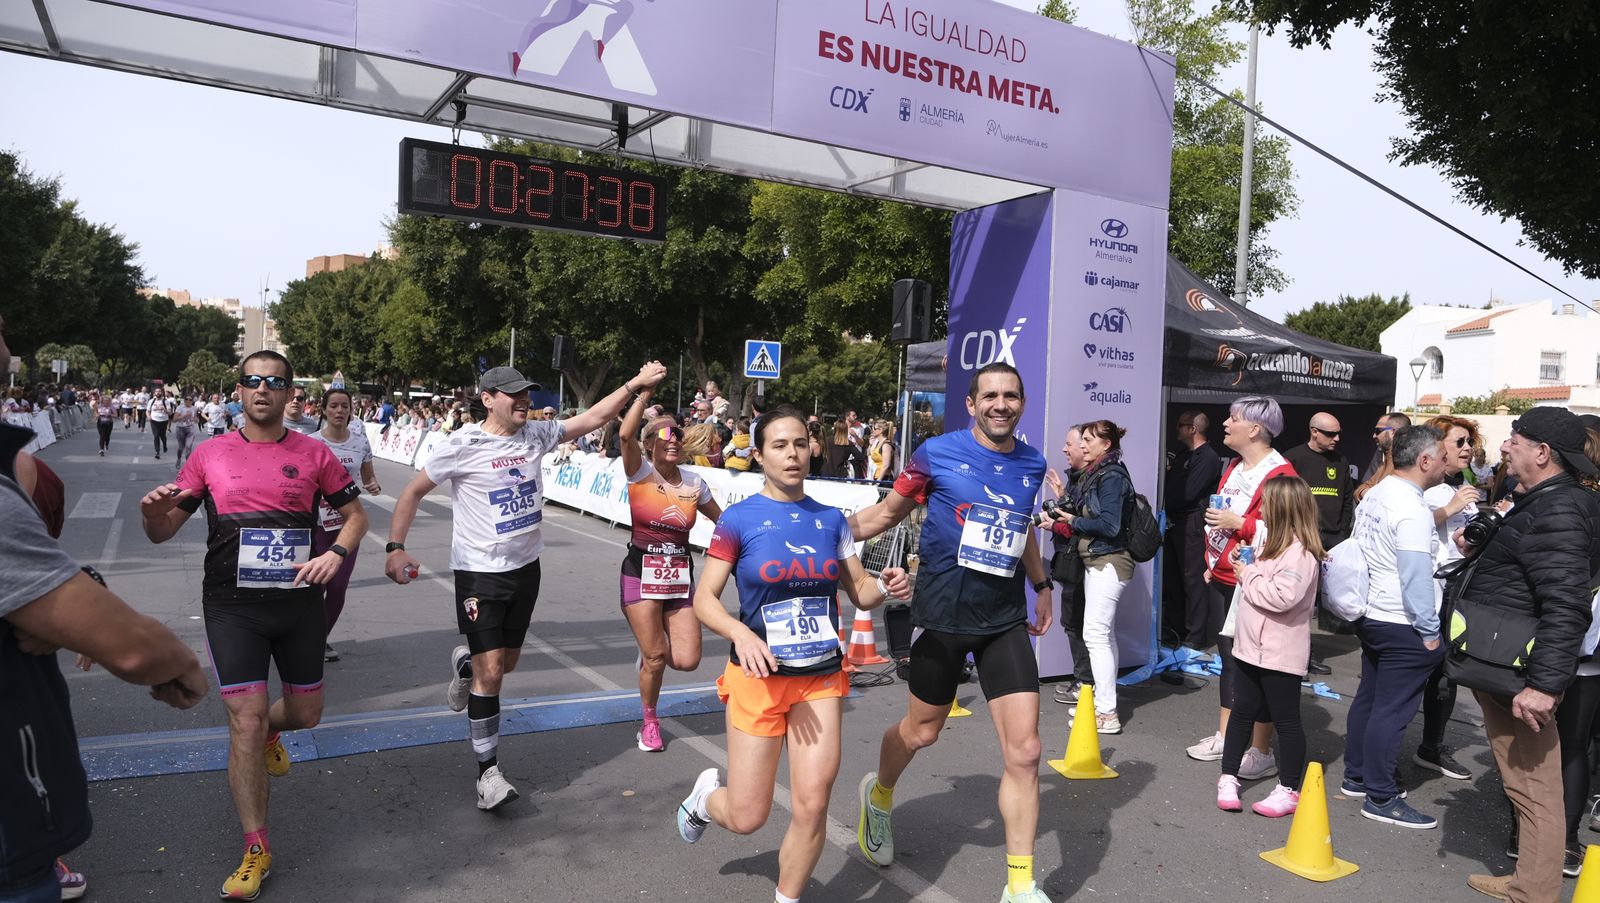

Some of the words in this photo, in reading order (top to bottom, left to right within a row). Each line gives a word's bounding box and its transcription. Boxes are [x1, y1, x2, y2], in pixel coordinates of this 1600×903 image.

[865, 0, 896, 29] LA
[904, 7, 1027, 63] IGUALDAD
[818, 30, 854, 63] ES
[861, 40, 983, 97] NUESTRA
[988, 74, 1060, 115] META.
[829, 85, 875, 114] CDX
[920, 103, 965, 124] ALMERÍA
[450, 153, 656, 232] 00:27:38
[1089, 237, 1138, 254] HYUNDAI
[1095, 250, 1133, 264] Almerialva
[1100, 275, 1140, 290] cajamar
[1089, 311, 1124, 333] CASI
[959, 317, 1027, 371] CDX
[1099, 345, 1135, 362] vithas
[1089, 390, 1132, 406] aqualia
[491, 456, 528, 470] MUJER
[499, 495, 535, 517] 2045
[982, 525, 1015, 548] 191
[256, 546, 297, 562] 454
[653, 568, 680, 580] 924
[759, 557, 840, 583] GALO
[788, 581, 819, 589] SPORT
[785, 616, 820, 636] 190
